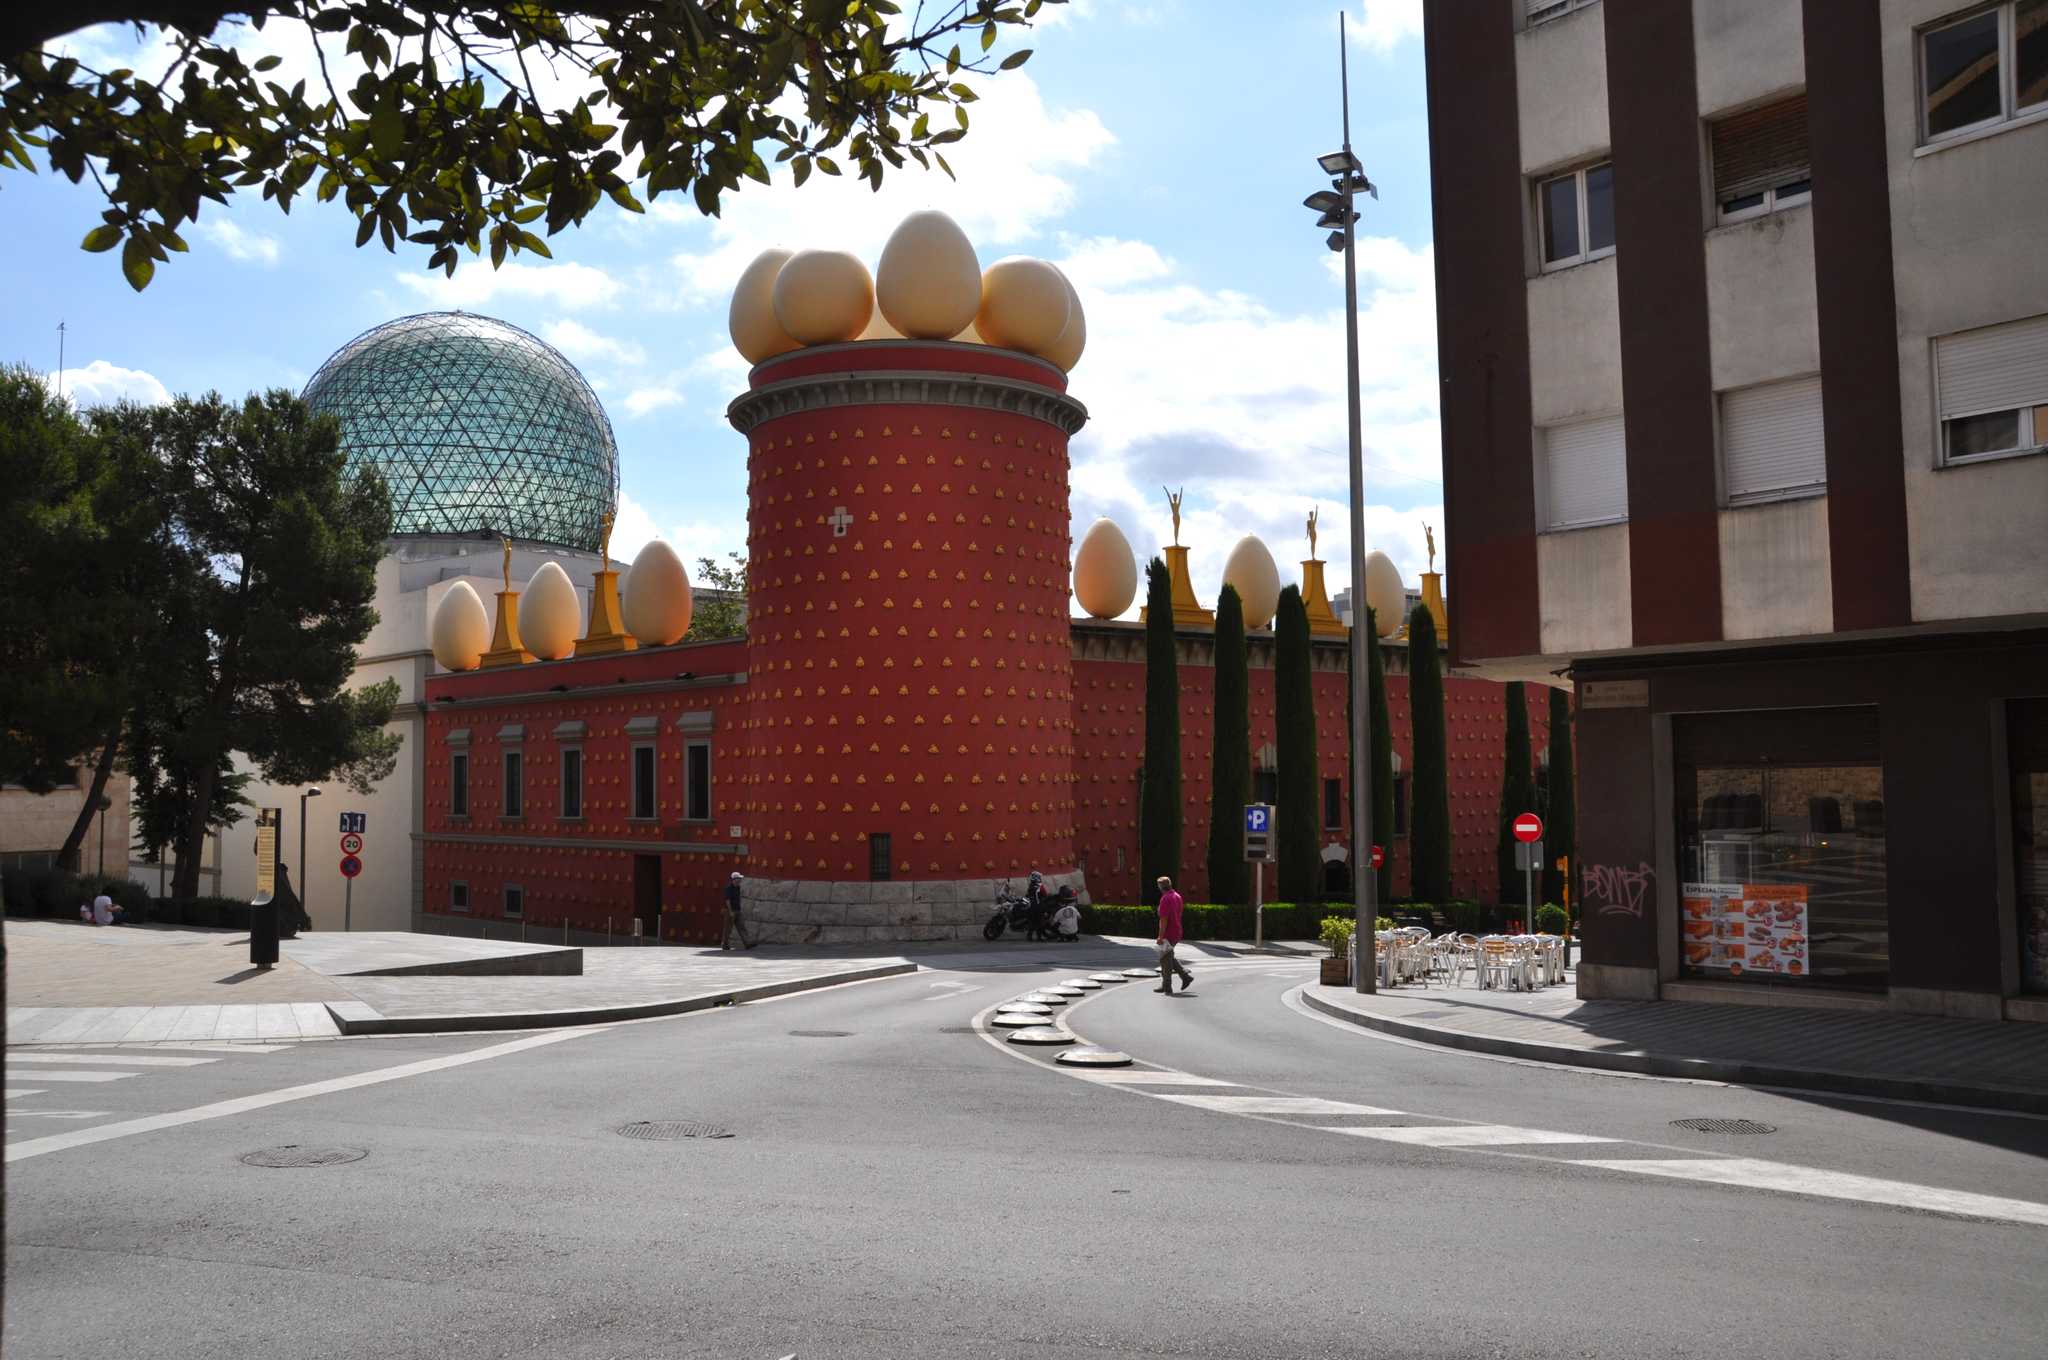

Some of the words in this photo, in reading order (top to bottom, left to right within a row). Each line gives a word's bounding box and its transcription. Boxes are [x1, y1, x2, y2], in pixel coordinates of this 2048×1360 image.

[1253, 810, 1265, 829] P
[346, 840, 358, 848] 20
[1686, 885, 1716, 894] ESPECIAL
